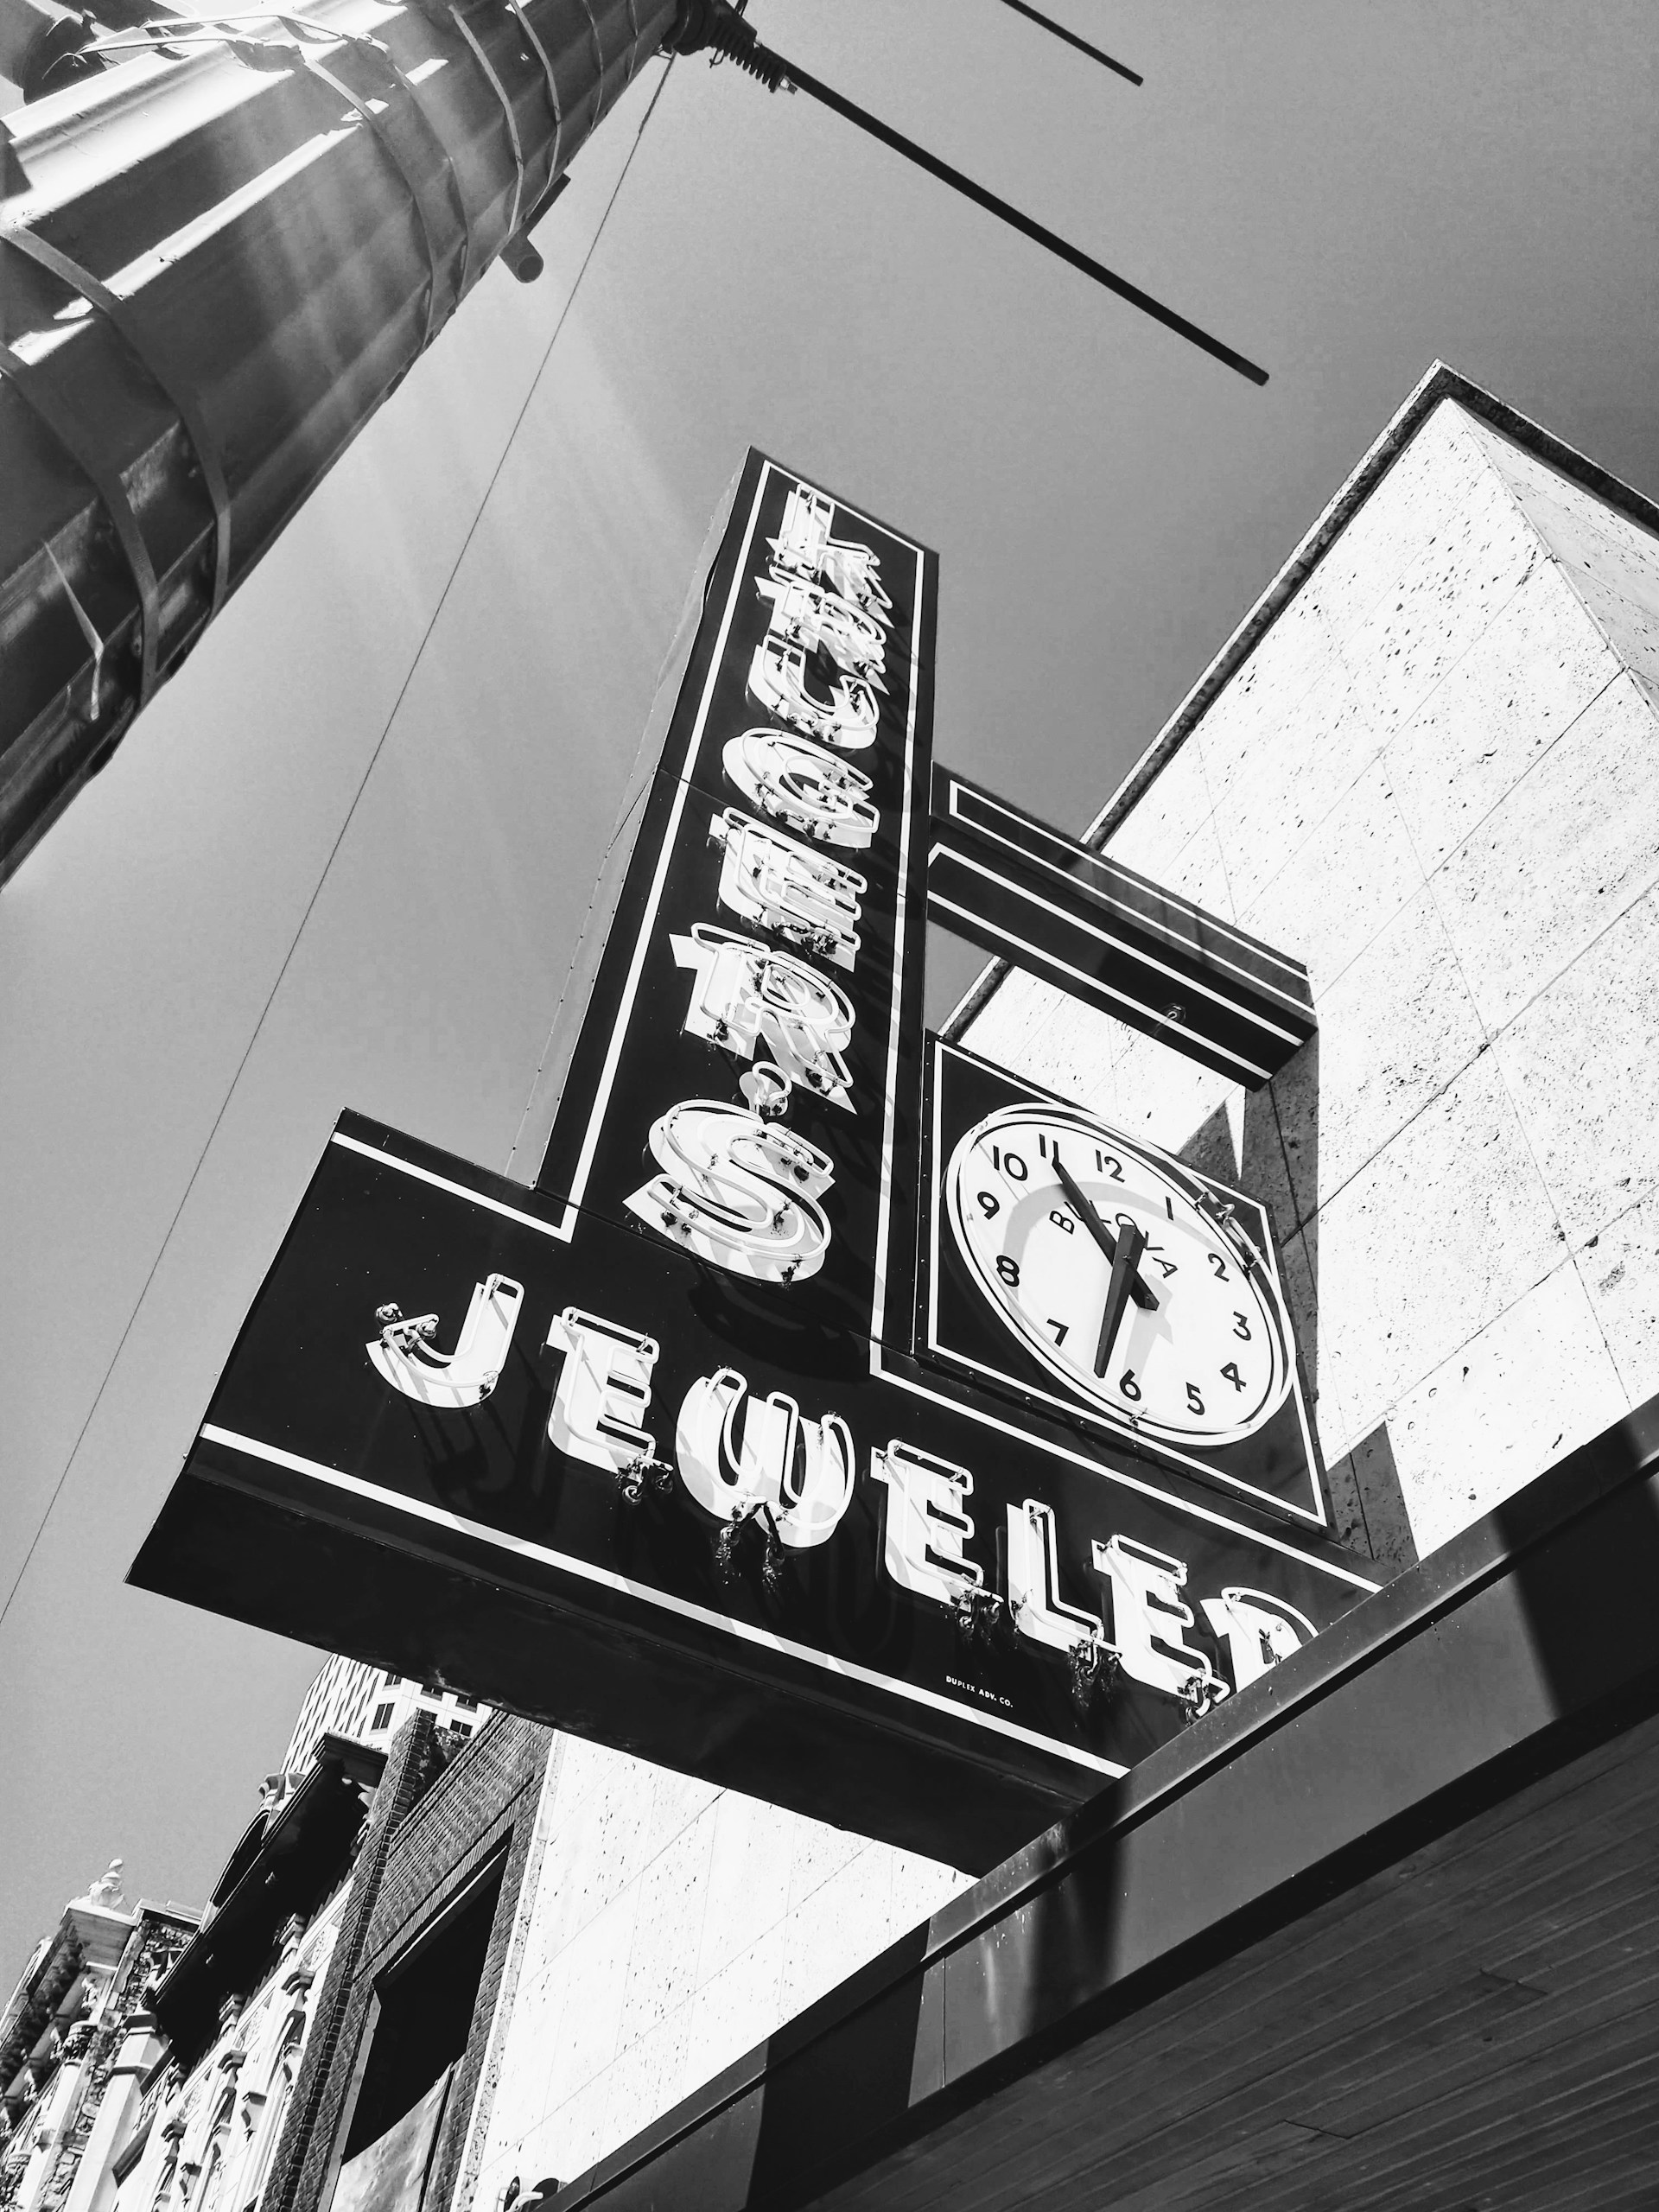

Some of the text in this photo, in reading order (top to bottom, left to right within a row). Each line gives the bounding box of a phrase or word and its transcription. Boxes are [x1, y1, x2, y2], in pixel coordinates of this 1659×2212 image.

[993, 1146, 1028, 1181] 10
[1039, 1134, 1058, 1164] 11
[1096, 1150, 1125, 1182] 12
[977, 1192, 1001, 1220] 9
[1166, 1197, 1173, 1220] 1
[995, 1255, 1020, 1287] 8
[1207, 1253, 1230, 1282] 2
[1046, 1319, 1070, 1347] 7
[1232, 1312, 1252, 1341] 3
[1120, 1369, 1141, 1401] 6
[1219, 1362, 1247, 1393] 4
[1185, 1382, 1205, 1415] 5
[945, 1675, 1014, 1708] DUPLEX ADV. CO.
